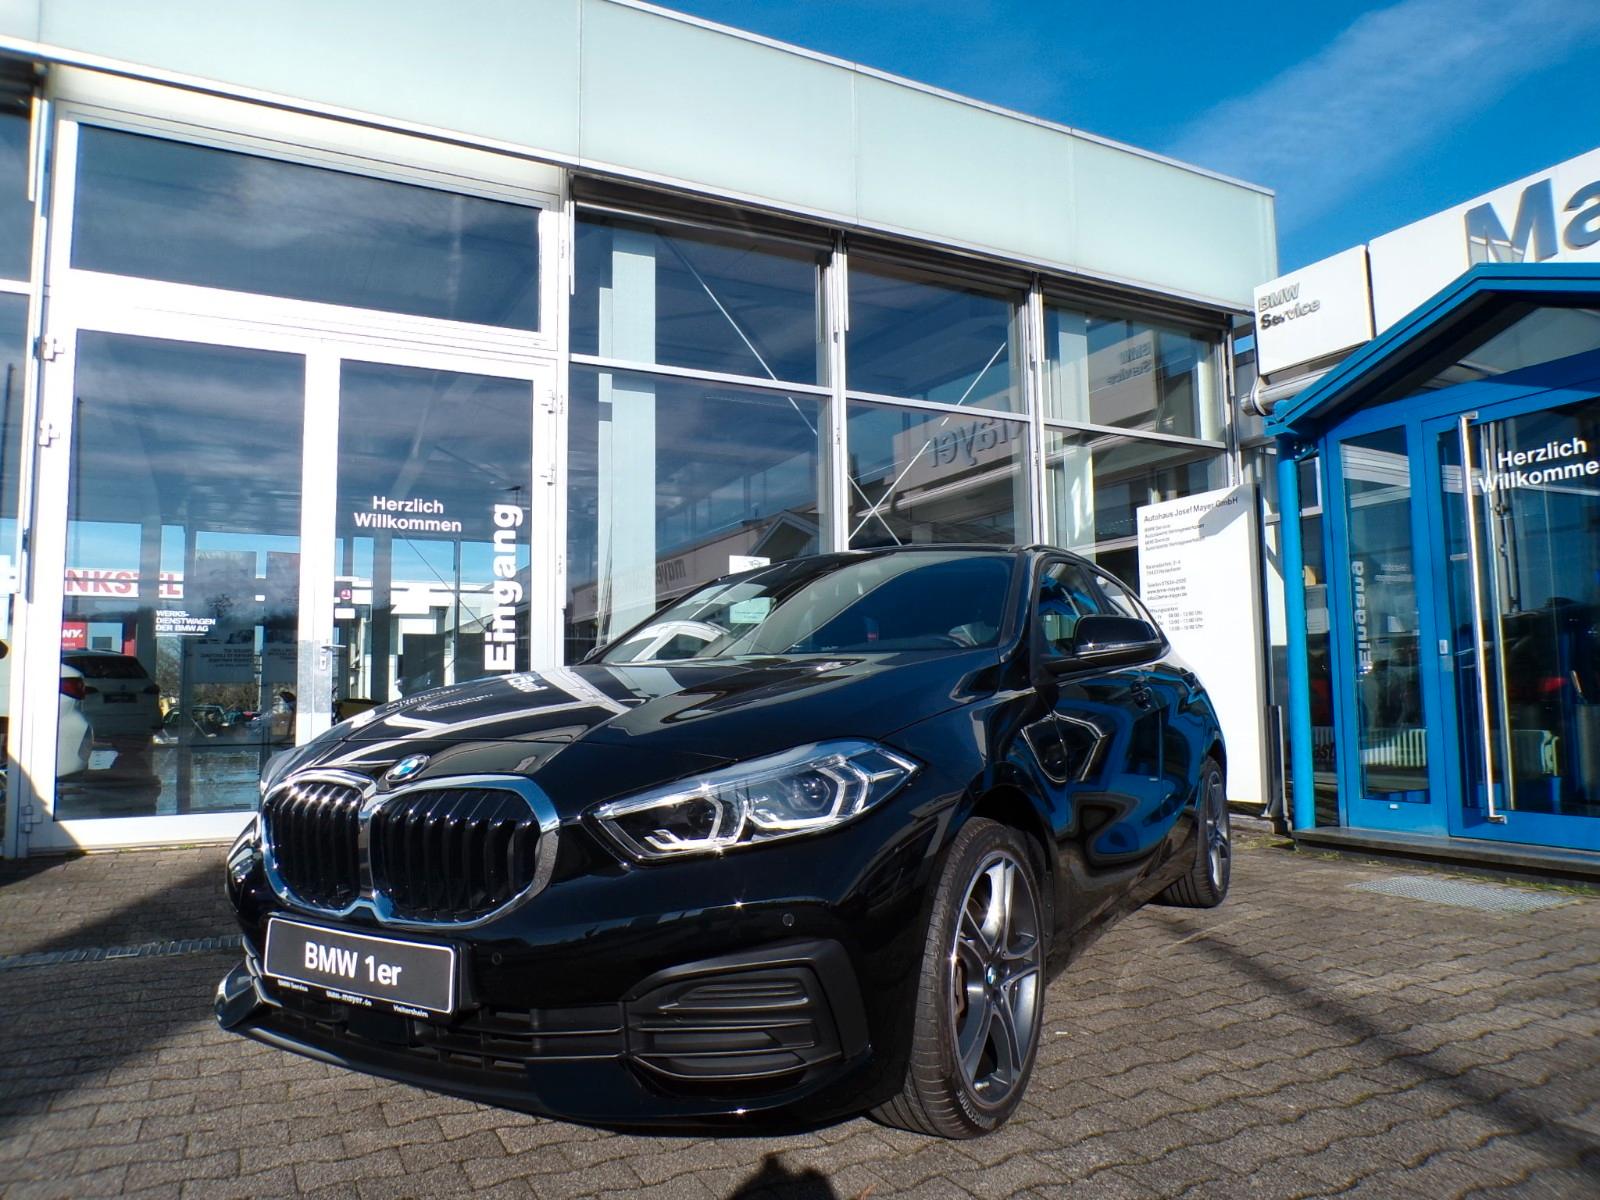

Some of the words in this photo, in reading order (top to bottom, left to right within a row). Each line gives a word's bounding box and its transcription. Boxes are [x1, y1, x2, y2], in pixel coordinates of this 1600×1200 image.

[1258, 283, 1300, 312] BMW
[1260, 299, 1321, 330] Service
[1498, 438, 1588, 469] Herzlich
[1478, 460, 1600, 493] Willkomme
[373, 495, 444, 514] Herzlich
[1143, 512, 1174, 522] Autohaus
[1174, 505, 1193, 517] Josef
[1193, 503, 1214, 513] Mayer
[1215, 496, 1239, 508] GmbH
[353, 512, 462, 532] Willkommen
[484, 503, 524, 671] Eingang
[155, 617, 216, 625] DIENSTWAGEN
[175, 624, 196, 632] BMW
[304, 941, 358, 978] BMW
[364, 955, 402, 986] 1er
